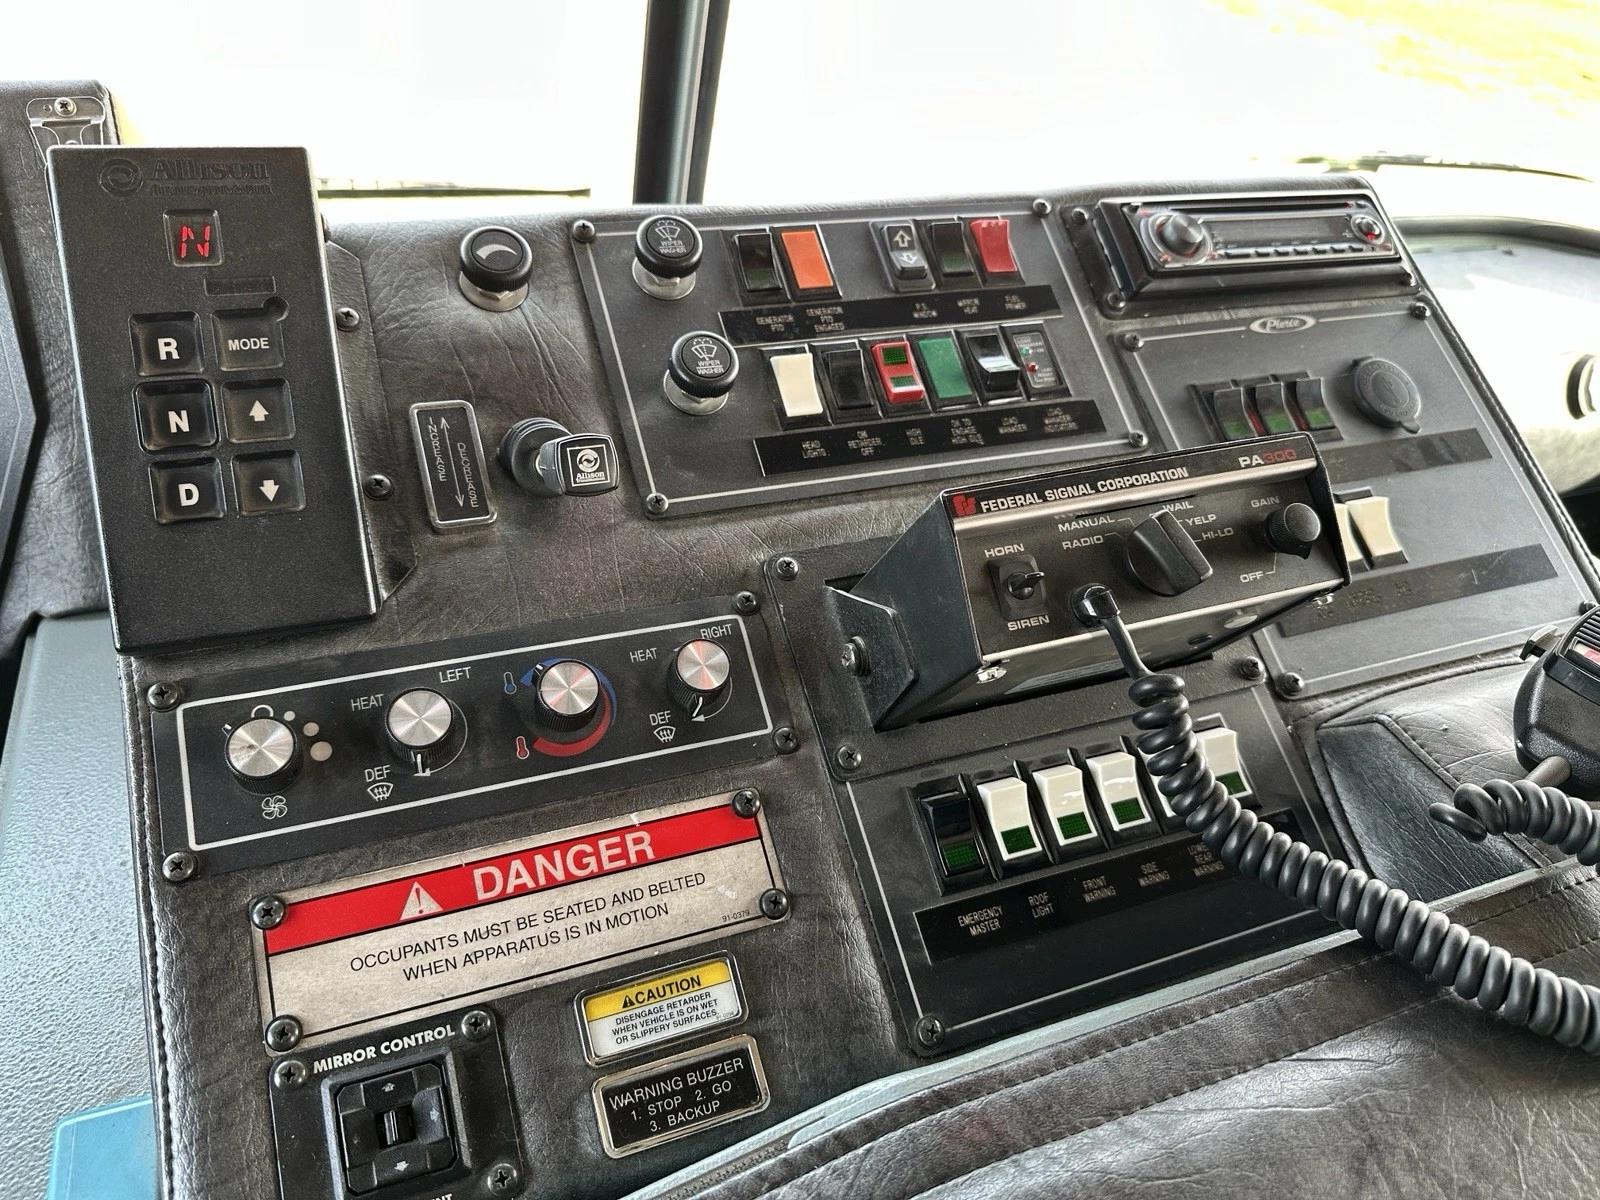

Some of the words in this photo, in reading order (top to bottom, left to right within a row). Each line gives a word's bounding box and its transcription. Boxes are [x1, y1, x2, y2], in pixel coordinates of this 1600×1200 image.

[177, 224, 213, 258] N
[660, 239, 683, 247] WIPER
[756, 314, 794, 325] GENERATOR
[806, 306, 844, 317] GENERATOR
[157, 337, 180, 361] R
[228, 337, 270, 352] MODE
[697, 367, 725, 375] WASHER
[698, 359, 721, 367] WIPER
[168, 410, 190, 433] N
[428, 416, 448, 482] INCREASE
[1238, 448, 1297, 468] PA300
[457, 442, 479, 508] DECREASE
[576, 471, 605, 480] Allison
[178, 483, 199, 506] D
[980, 494, 1043, 513] FEDERAL
[1047, 483, 1096, 501] SIGNAL
[1097, 466, 1189, 491] CORPORATION
[1162, 501, 1194, 512] WAIL
[1250, 496, 1280, 508] GAIN
[1058, 515, 1115, 533] MANUAL
[1185, 514, 1217, 526] YELP
[1062, 535, 1104, 550] RADIO
[1202, 527, 1234, 540] HI-LO
[984, 543, 1025, 558] HORN
[1240, 571, 1264, 583] OFF
[700, 623, 733, 640] RIGHT
[1007, 615, 1050, 631] SIREN
[630, 647, 658, 663] HEAT
[438, 666, 472, 684] LEFT
[350, 693, 384, 712] HEAT
[649, 710, 673, 727] DEF
[364, 764, 391, 783] DEF
[472, 829, 656, 901] DANGER
[1193, 860, 1224, 877] WARNING
[1082, 875, 1107, 891] FRONT
[1137, 870, 1170, 887] WARNING
[1027, 891, 1049, 906] ROOF
[1082, 885, 1117, 903] WARNING
[721, 909, 750, 922] 91-0379
[957, 905, 1004, 927] EMERGENCY
[1031, 903, 1055, 918] LIGHT
[350, 933, 459, 972] OCCUPANTS
[463, 919, 511, 945] MUST
[516, 913, 540, 931] BE
[543, 896, 606, 924] SEATED
[611, 887, 645, 907] AND
[648, 872, 706, 897] BELTED
[969, 918, 1001, 937] MASTER
[403, 956, 457, 982] WHEN
[462, 930, 561, 967] APPARATUS
[565, 925, 581, 941] IS
[585, 919, 602, 936] IN
[605, 902, 670, 929] MOTION
[634, 975, 702, 1004] CAUTION
[612, 1022, 638, 1036] WHEN
[640, 1012, 674, 1030] VEHICLE
[676, 1009, 685, 1017] IS
[686, 1004, 699, 1014] ON
[700, 999, 718, 1010] WET
[615, 1005, 665, 1026] DISENGAGE
[666, 991, 712, 1012] RETARDER
[615, 1035, 629, 1045] OR
[630, 1025, 671, 1041] SLIPPERY
[673, 1009, 720, 1029] SURFACES.
[312, 1045, 377, 1074] MIRROR
[380, 1024, 456, 1055] CONTROL
[609, 1076, 683, 1110] WARNING
[686, 1057, 744, 1086] BUZZER
[631, 1109, 642, 1121] 1.
[648, 1096, 682, 1116] STOP
[695, 1089, 706, 1101] 2.
[712, 1080, 732, 1095] GO
[650, 1120, 661, 1132] 3.
[667, 1100, 720, 1126] BACKUP
